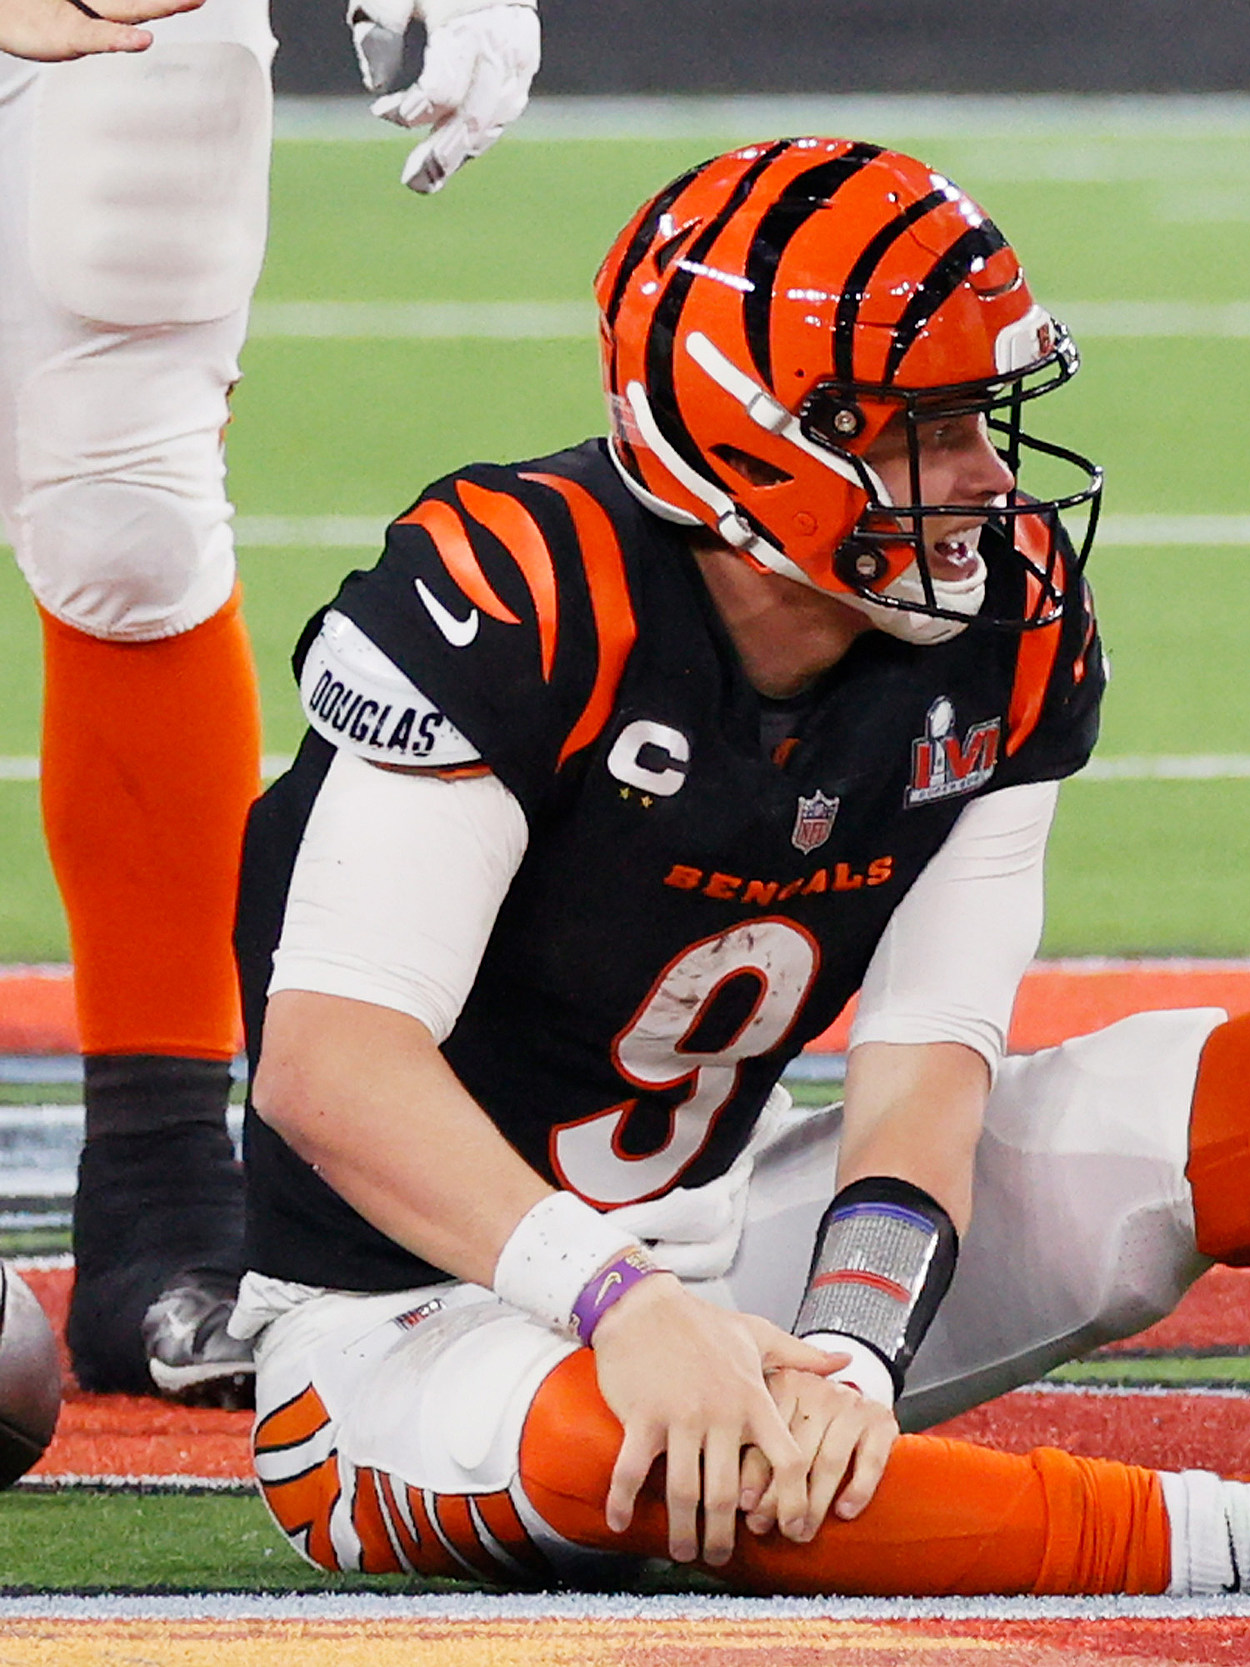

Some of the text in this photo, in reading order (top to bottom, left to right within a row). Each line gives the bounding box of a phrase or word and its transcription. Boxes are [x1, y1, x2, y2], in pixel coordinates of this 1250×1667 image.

[309, 669, 444, 757] DOUGLAS
[607, 719, 690, 797] C
[549, 914, 821, 1213] 9
